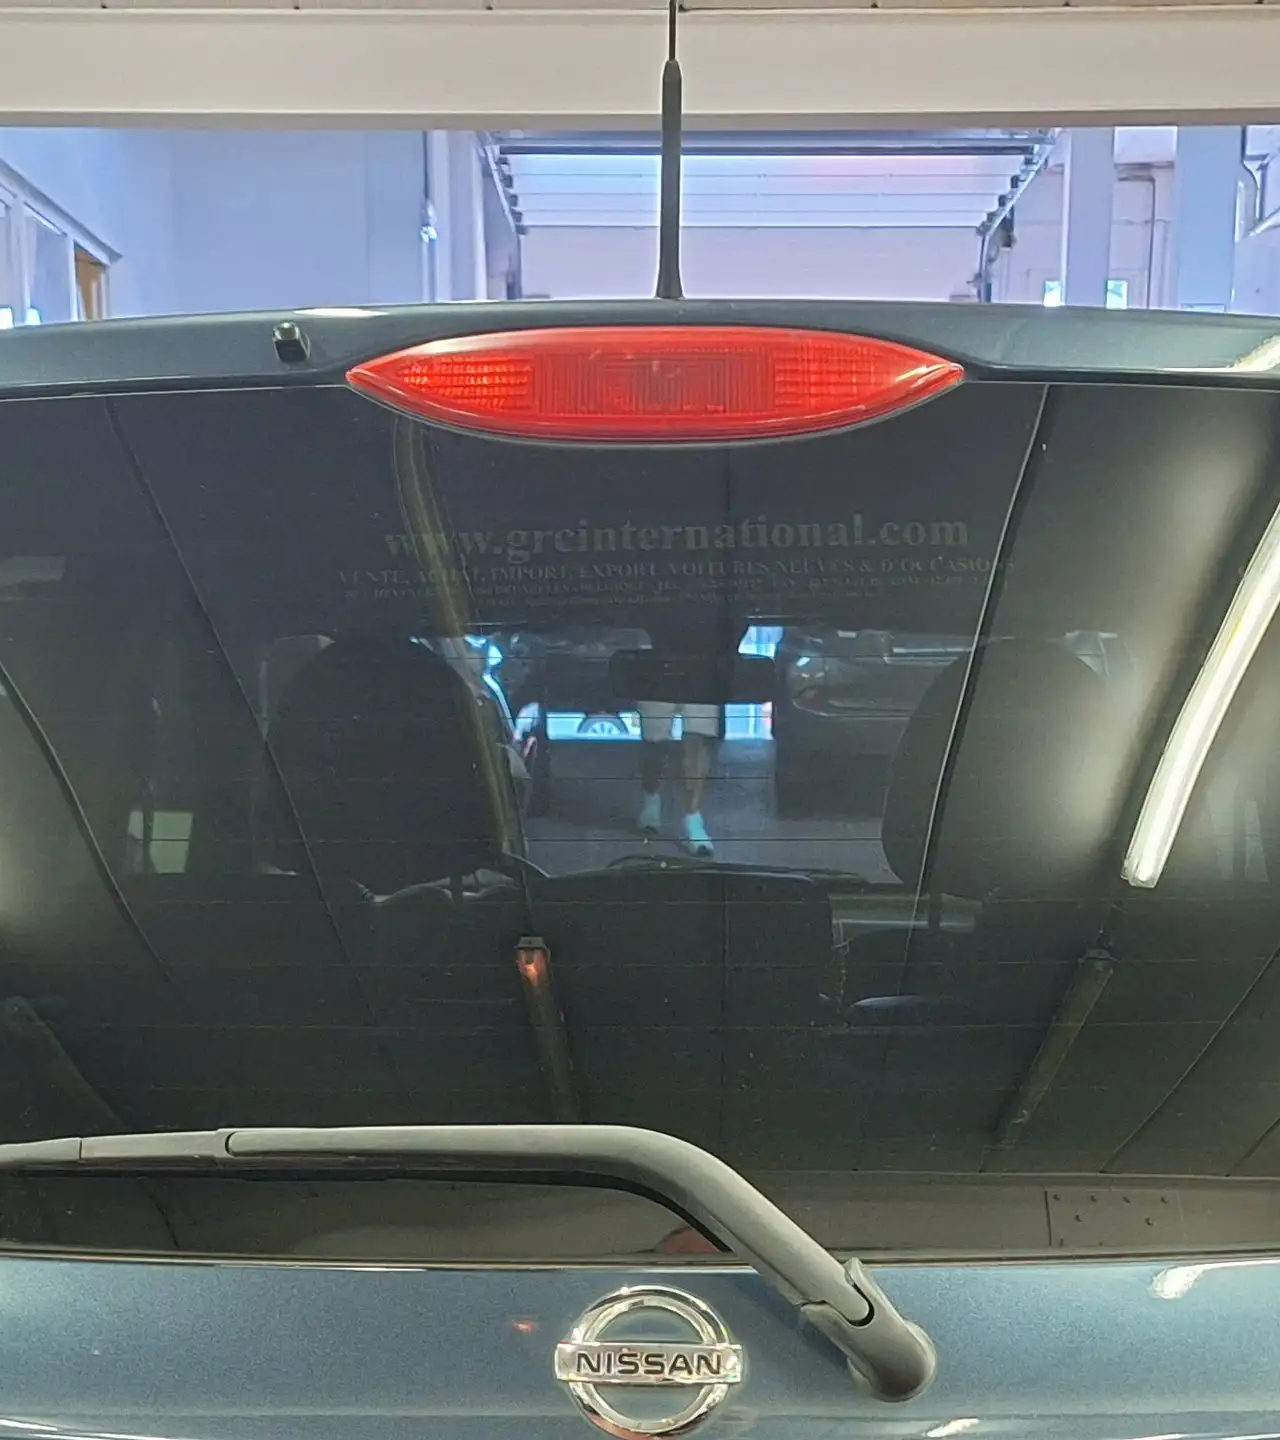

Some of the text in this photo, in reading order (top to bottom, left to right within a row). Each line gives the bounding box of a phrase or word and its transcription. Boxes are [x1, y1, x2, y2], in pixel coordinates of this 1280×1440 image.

[384, 512, 969, 564] www.grcinternational.com
[880, 555, 1016, 573] D'OCCASIOS
[575, 1351, 721, 1376] NISSAN
